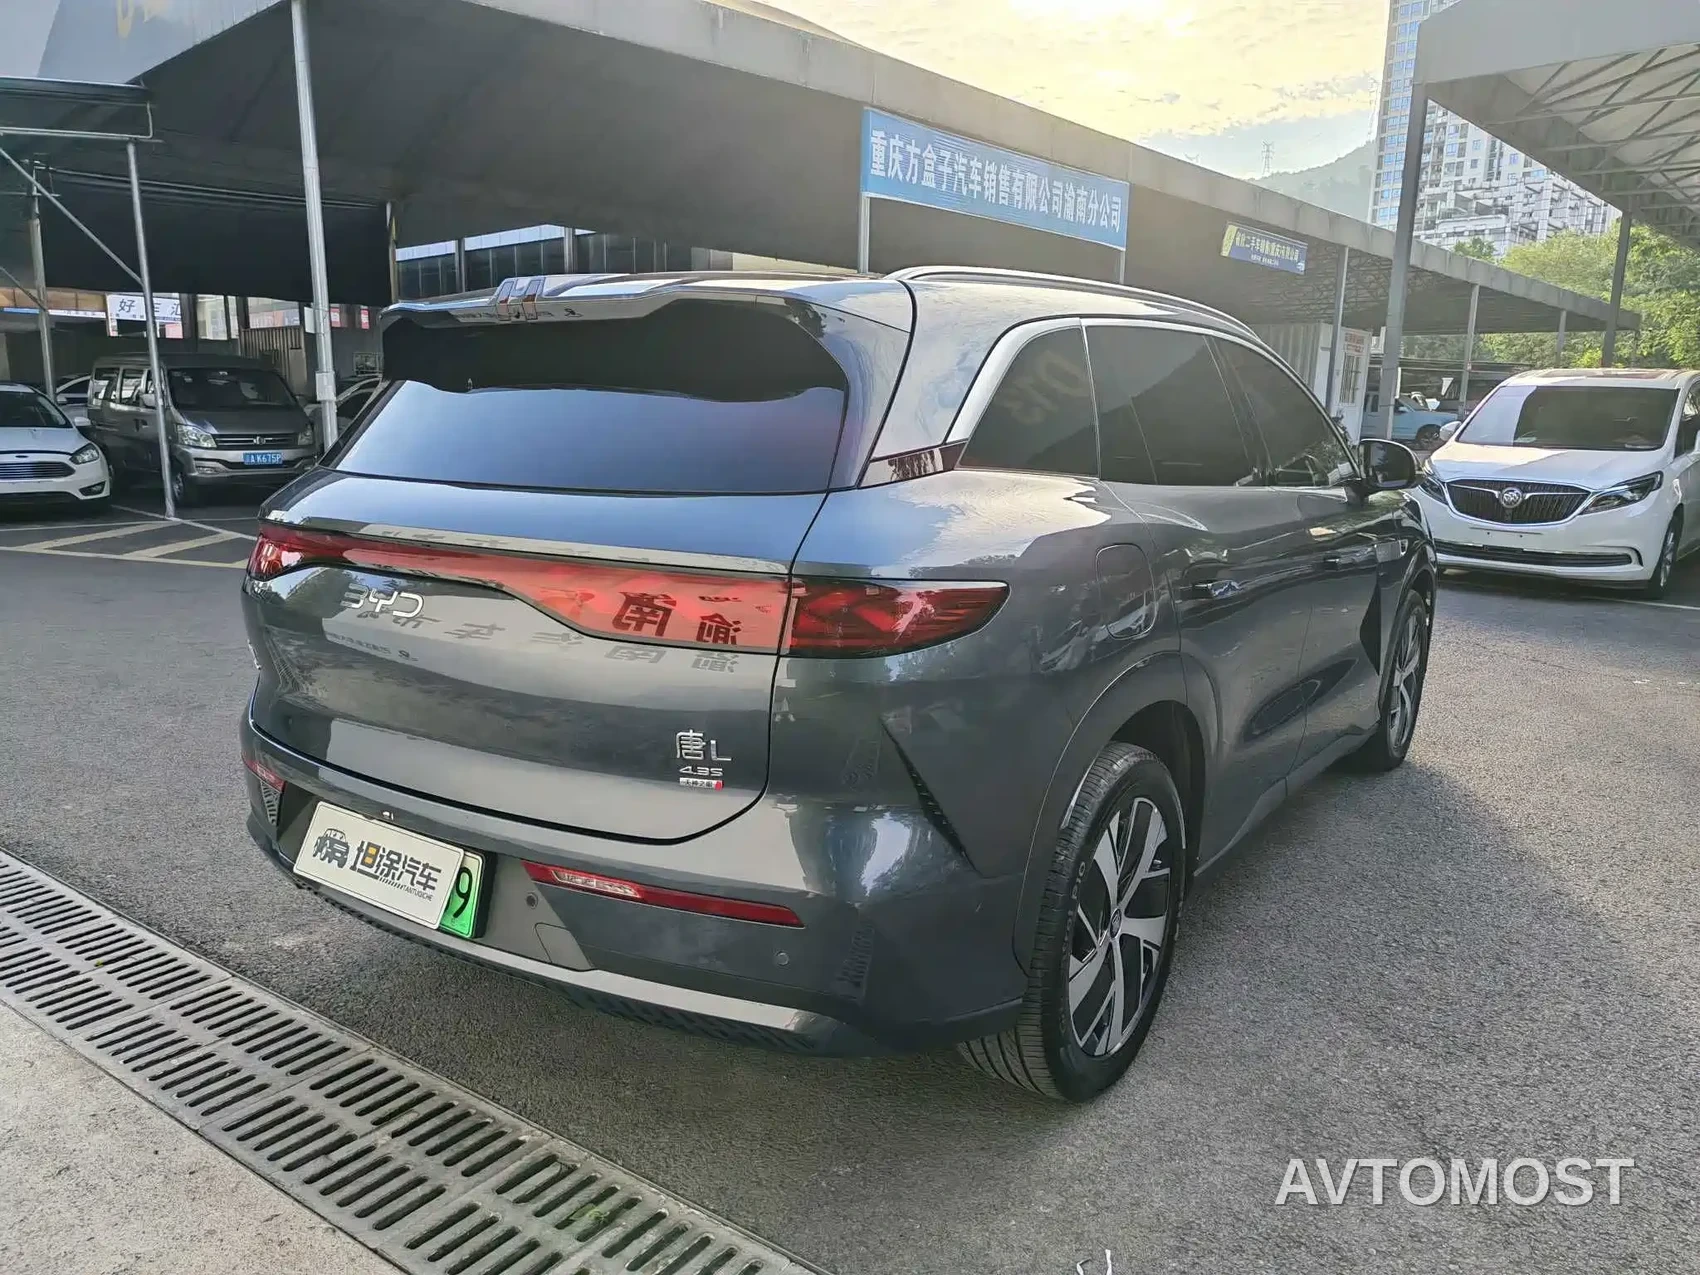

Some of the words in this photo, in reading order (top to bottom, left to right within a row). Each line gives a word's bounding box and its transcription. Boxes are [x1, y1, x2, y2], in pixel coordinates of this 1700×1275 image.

[871, 130, 1121, 233] 重庆方盒子汽车销售有限公司渝南分公司
[340, 583, 424, 618] BYD
[679, 765, 723, 777] 4.3S
